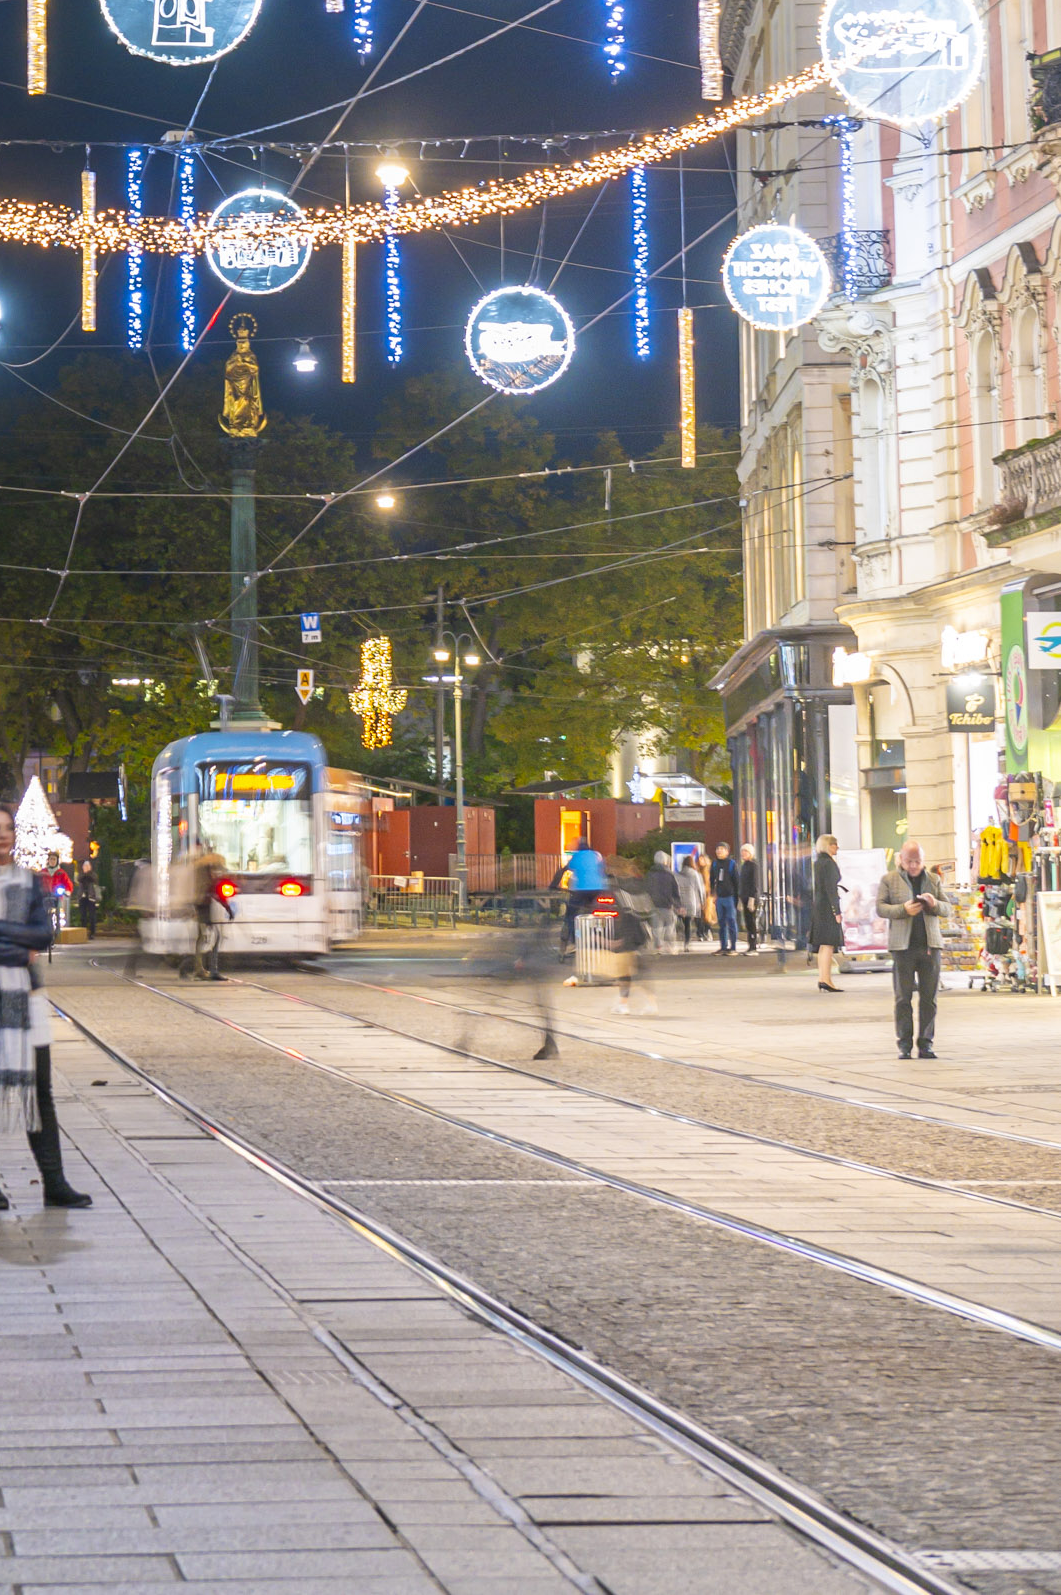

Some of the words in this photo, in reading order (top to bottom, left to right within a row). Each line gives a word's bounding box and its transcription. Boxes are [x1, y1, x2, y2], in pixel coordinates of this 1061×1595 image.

[302, 616, 318, 630] W
[300, 672, 309, 686] A
[949, 713, 994, 725] Tchibo
